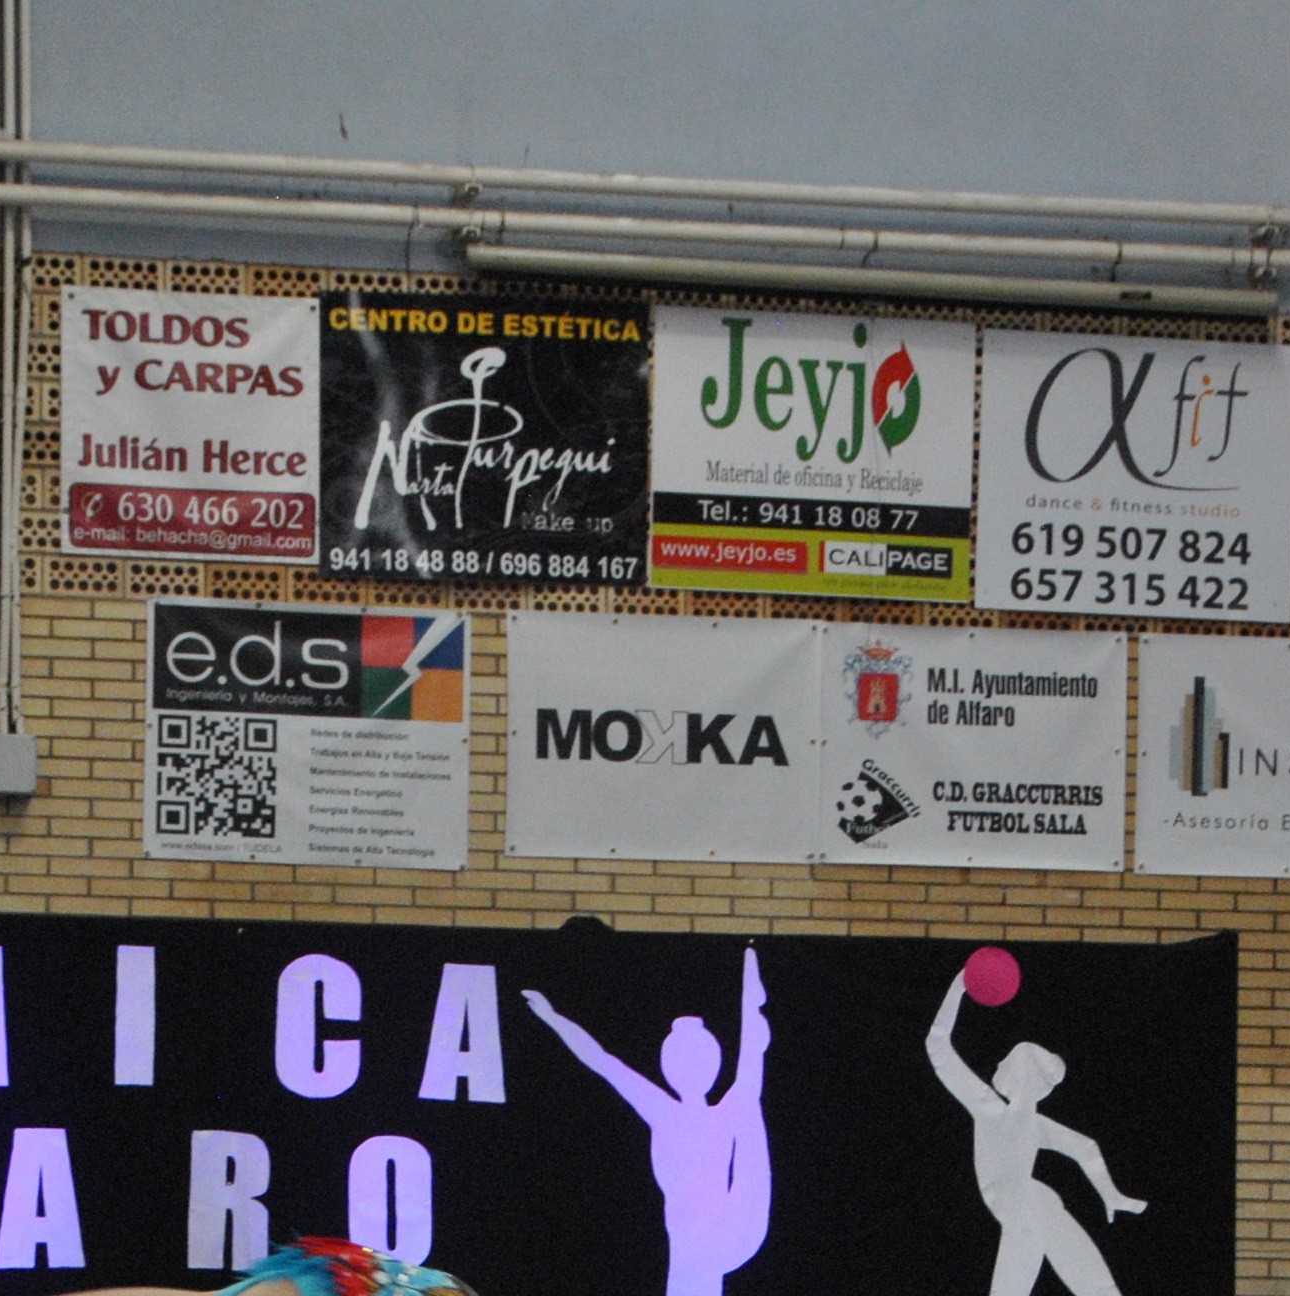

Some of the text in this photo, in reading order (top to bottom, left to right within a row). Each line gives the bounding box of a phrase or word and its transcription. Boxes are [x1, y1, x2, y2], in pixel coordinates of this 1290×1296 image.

[81, 309, 250, 348] TOLDOS
[329, 307, 641, 341] CENTRO DE ESTÉTICA
[96, 359, 304, 397] y CARPAS
[701, 317, 921, 464] Jeyjo
[78, 434, 307, 476] Julián Herce
[706, 461, 923, 496] Material de oficina y Reciclaje
[117, 492, 304, 530] 630 466 202
[698, 500, 918, 530] Tel.: 941 18 08 77
[1026, 494, 1241, 518] dance & fitness studio
[587, 515, 613, 534] up
[73, 527, 312, 549] e-mail: behacha@gmail.com
[1012, 522, 1251, 565] 619 507 824
[329, 547, 371, 571] 941
[381, 549, 408, 572] 18
[415, 549, 444, 573] 48
[452, 550, 479, 574] 88
[500, 552, 541, 576] 696
[548, 555, 589, 578] 884
[598, 556, 637, 579] 167
[661, 541, 797, 563] www.jeyjo.es
[829, 547, 949, 571] CALIPAGE
[1010, 568, 1249, 611] 657 315 422
[167, 620, 349, 690] e.d.s
[927, 667, 1098, 699] M.I. Ayuntamiento
[240, 691, 247, 704] y
[927, 699, 1015, 727] de Alfaro
[341, 729, 352, 738] de
[311, 747, 348, 759] Trabajos
[378, 769, 390, 778] de
[309, 786, 351, 796] Servicios
[861, 758, 921, 818] Graccurris
[932, 781, 1103, 806] C.D. GRACCURRIS
[351, 806, 404, 817] Renovables
[947, 810, 1087, 835] FUTBOL SALA
[309, 823, 354, 835] Proyectos
[356, 826, 368, 835] de
[309, 842, 350, 853] Sistemas
